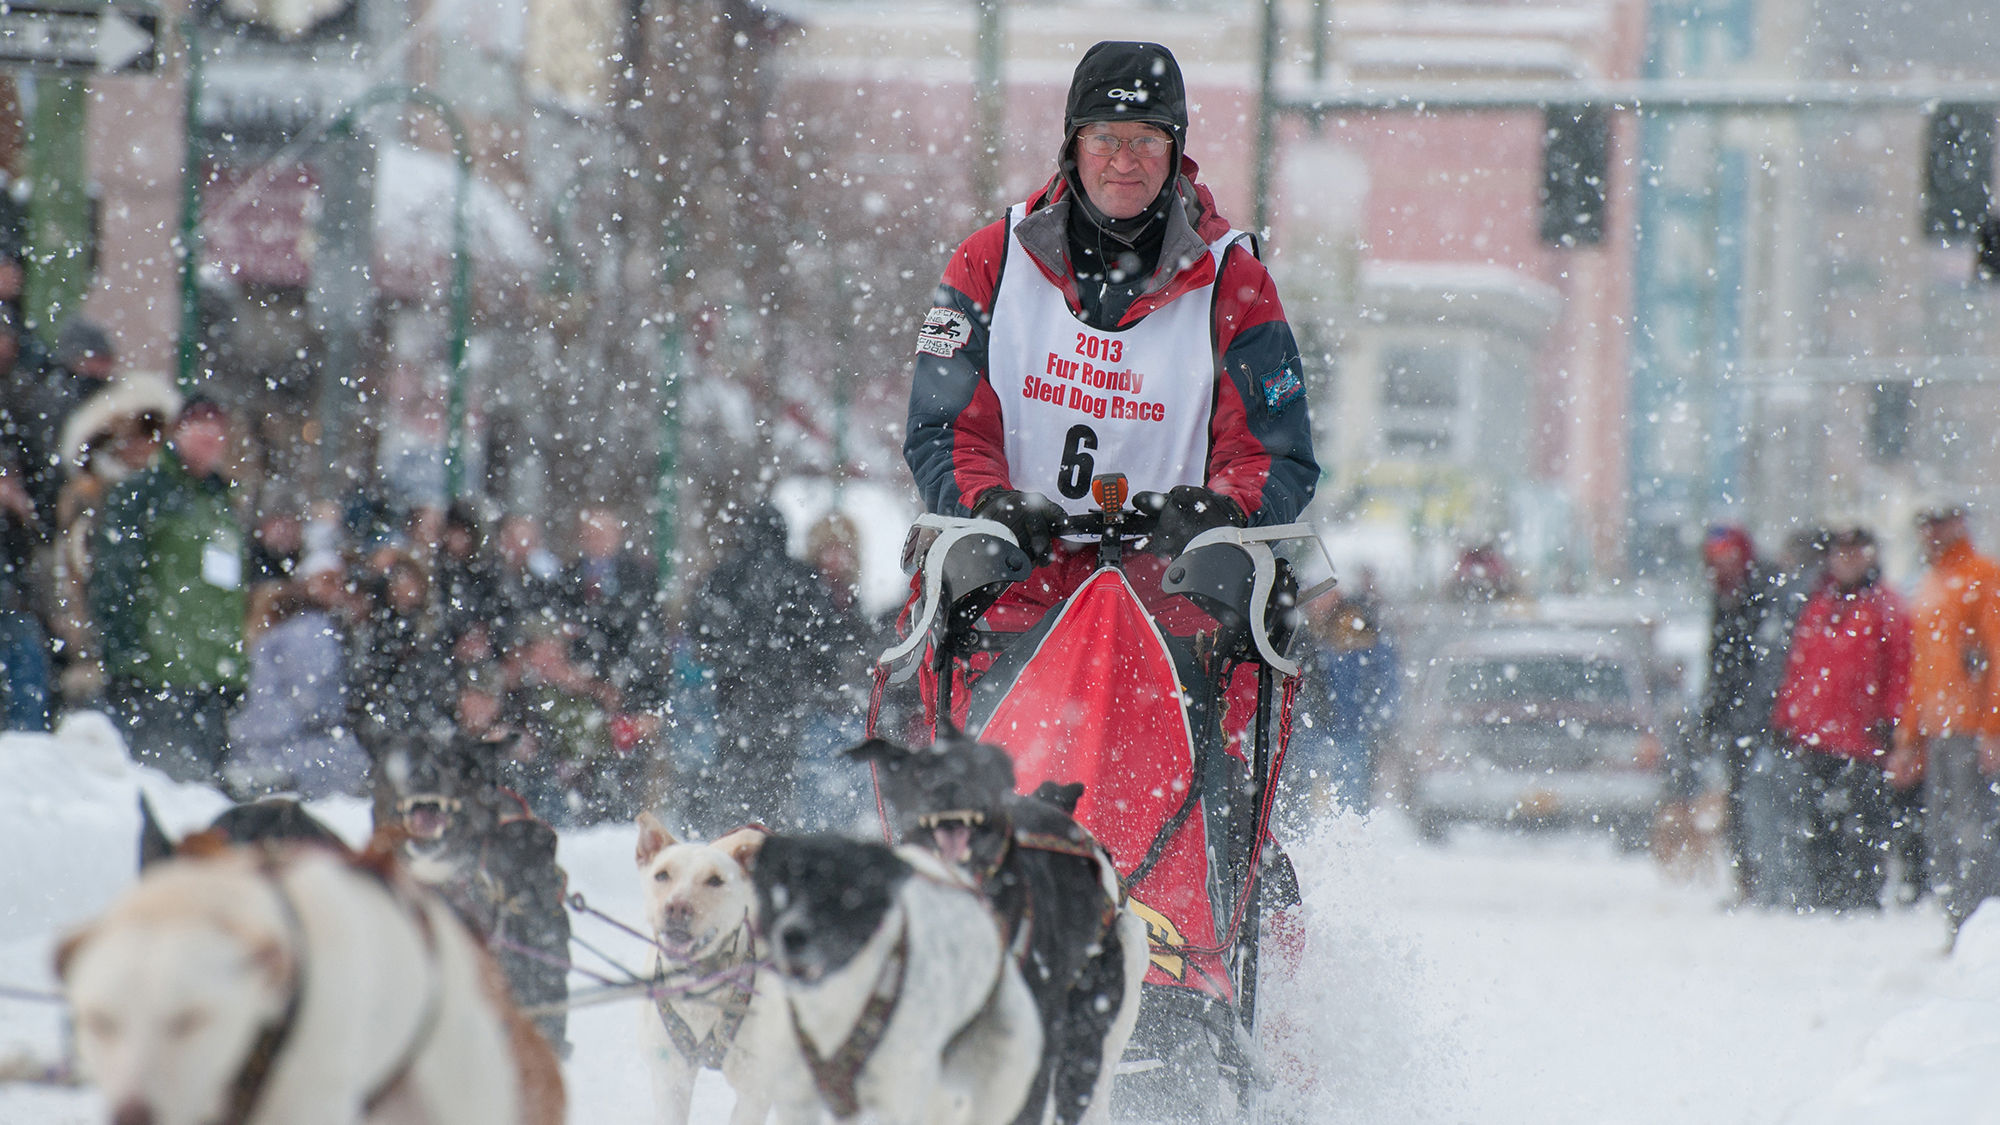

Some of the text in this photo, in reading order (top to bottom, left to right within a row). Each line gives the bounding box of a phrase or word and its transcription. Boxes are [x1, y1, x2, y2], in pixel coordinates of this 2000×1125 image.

[1107, 88, 1138, 101] OR
[1075, 332, 1123, 363] 2013
[1046, 352, 1144, 394] Fur Rondy
[1022, 375, 1165, 422] Sled Dog Race
[1057, 424, 1098, 500] 6
